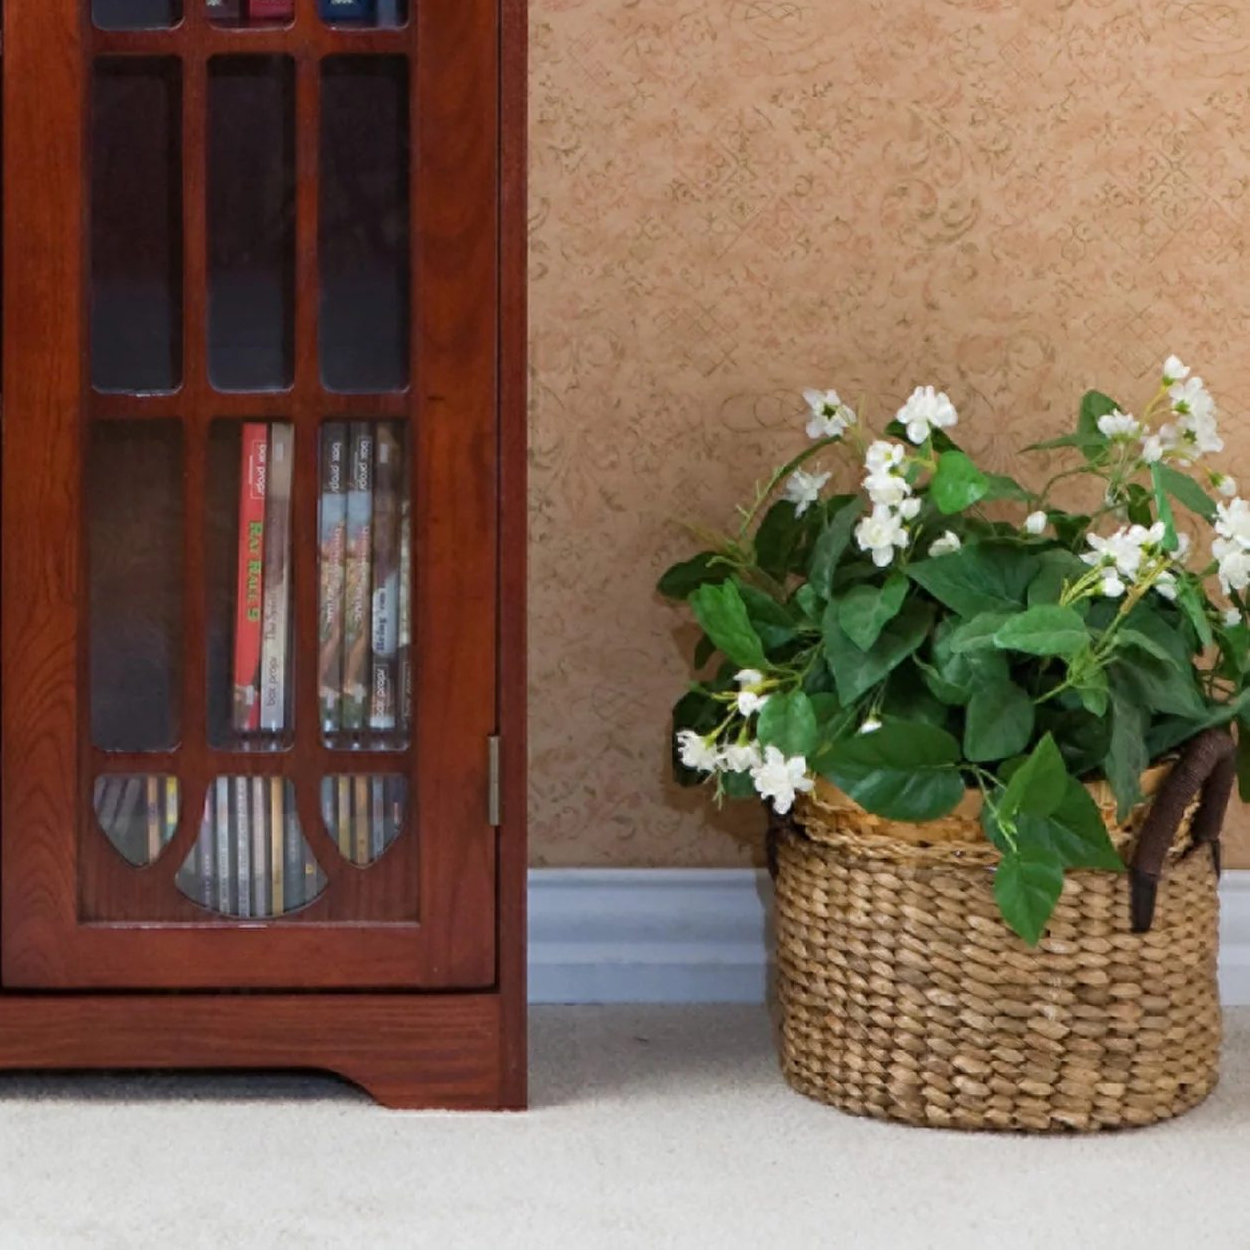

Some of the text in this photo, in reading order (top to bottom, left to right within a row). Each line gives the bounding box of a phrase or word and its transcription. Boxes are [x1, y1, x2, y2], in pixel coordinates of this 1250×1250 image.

[332, 442, 342, 462] box
[360, 440, 370, 459] box
[256, 443, 267, 495] box props
[266, 689, 276, 707] box
